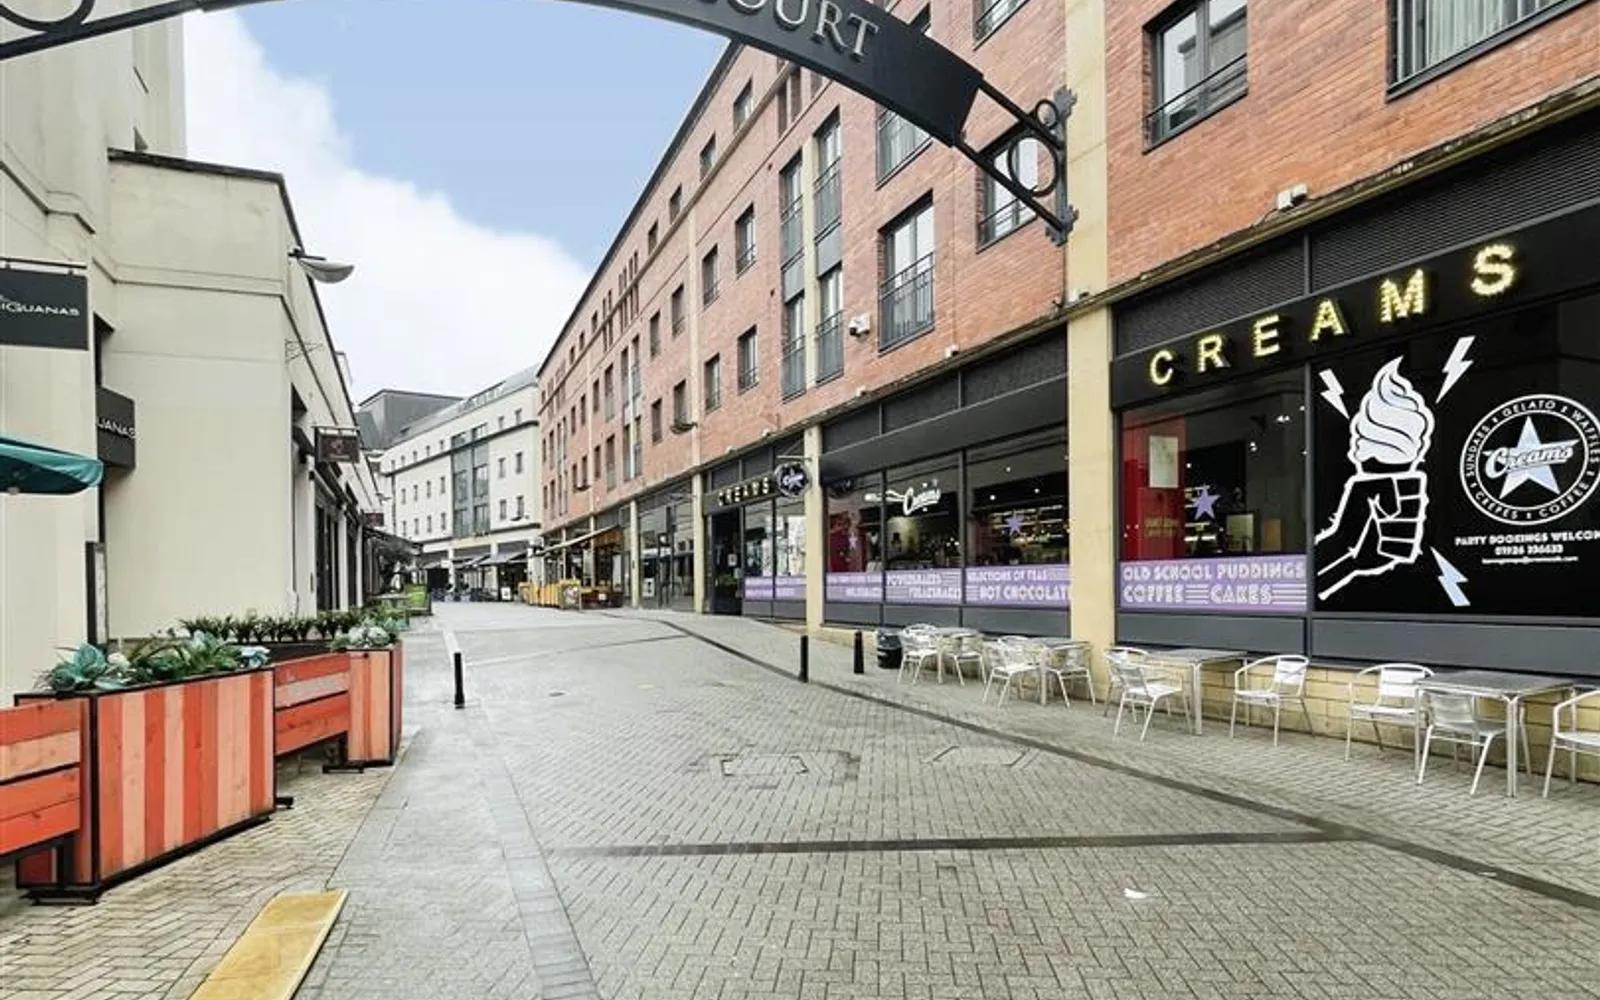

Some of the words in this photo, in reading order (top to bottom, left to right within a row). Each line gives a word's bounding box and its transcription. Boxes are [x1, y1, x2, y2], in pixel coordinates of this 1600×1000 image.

[734, 0, 880, 56] URT
[1, 301, 80, 316] IGUANAS
[1148, 243, 1519, 386] CREAMS
[1501, 400, 1556, 417] GELATO
[1484, 443, 1575, 479] Creams
[1475, 490, 1519, 520] CREPES
[1538, 482, 1589, 518] COFFEE
[1454, 536, 1487, 546] PARTY
[1489, 532, 1548, 545] BOOKINGS
[1122, 566, 1151, 581] OLD
[1153, 564, 1213, 581] SCHOOL
[1217, 562, 1306, 580] PUDDINGS
[1122, 584, 1185, 603] COFFEE
[1210, 584, 1273, 605] CAKES
